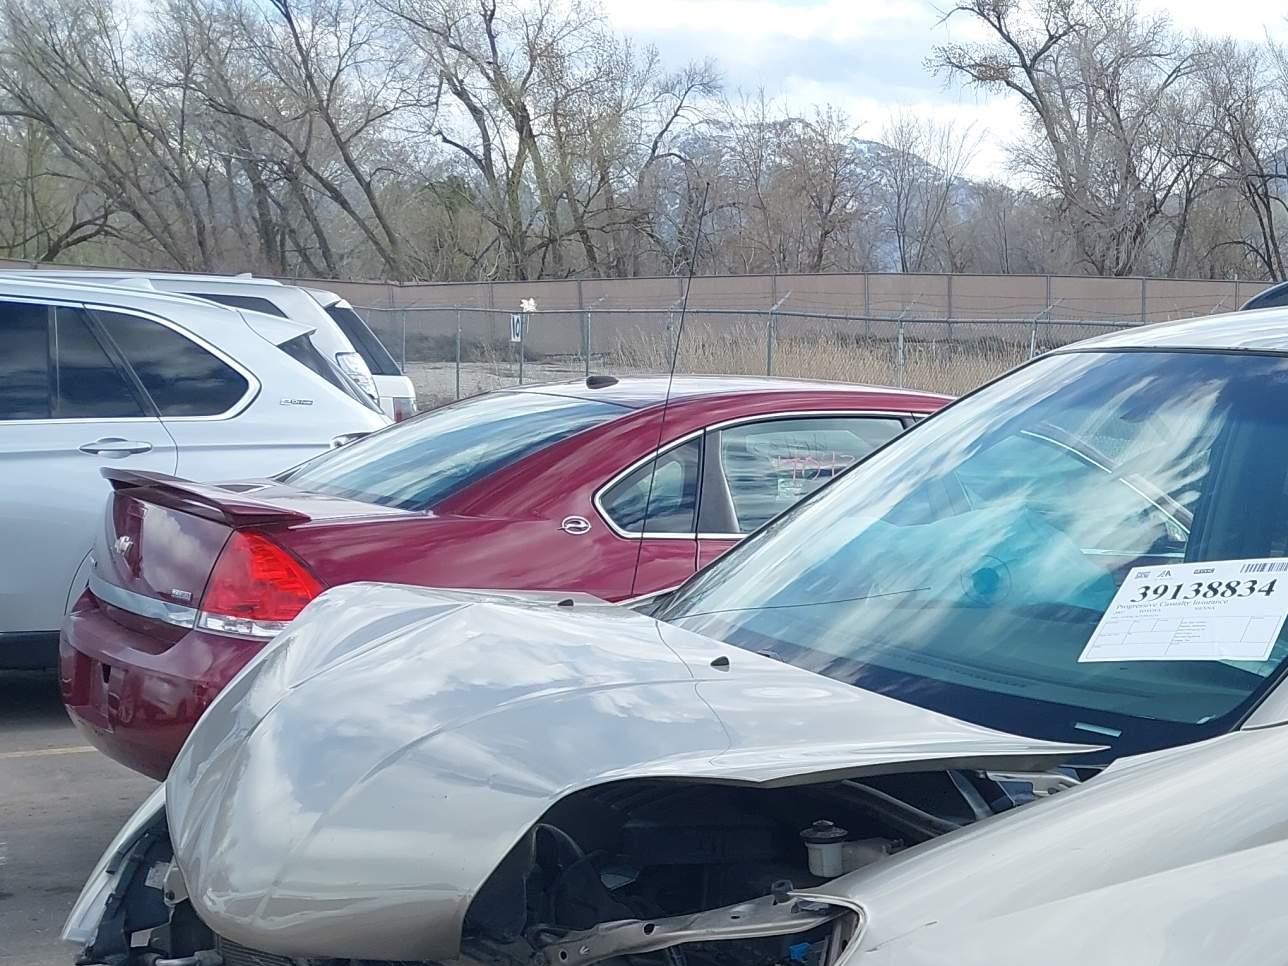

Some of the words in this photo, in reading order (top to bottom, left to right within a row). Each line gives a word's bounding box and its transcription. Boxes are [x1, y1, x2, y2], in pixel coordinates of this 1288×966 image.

[1130, 578, 1278, 603] 39138834
[1116, 601, 1158, 610] Progressive
[1160, 599, 1191, 608] Casualty
[1193, 598, 1229, 606] Insurance
